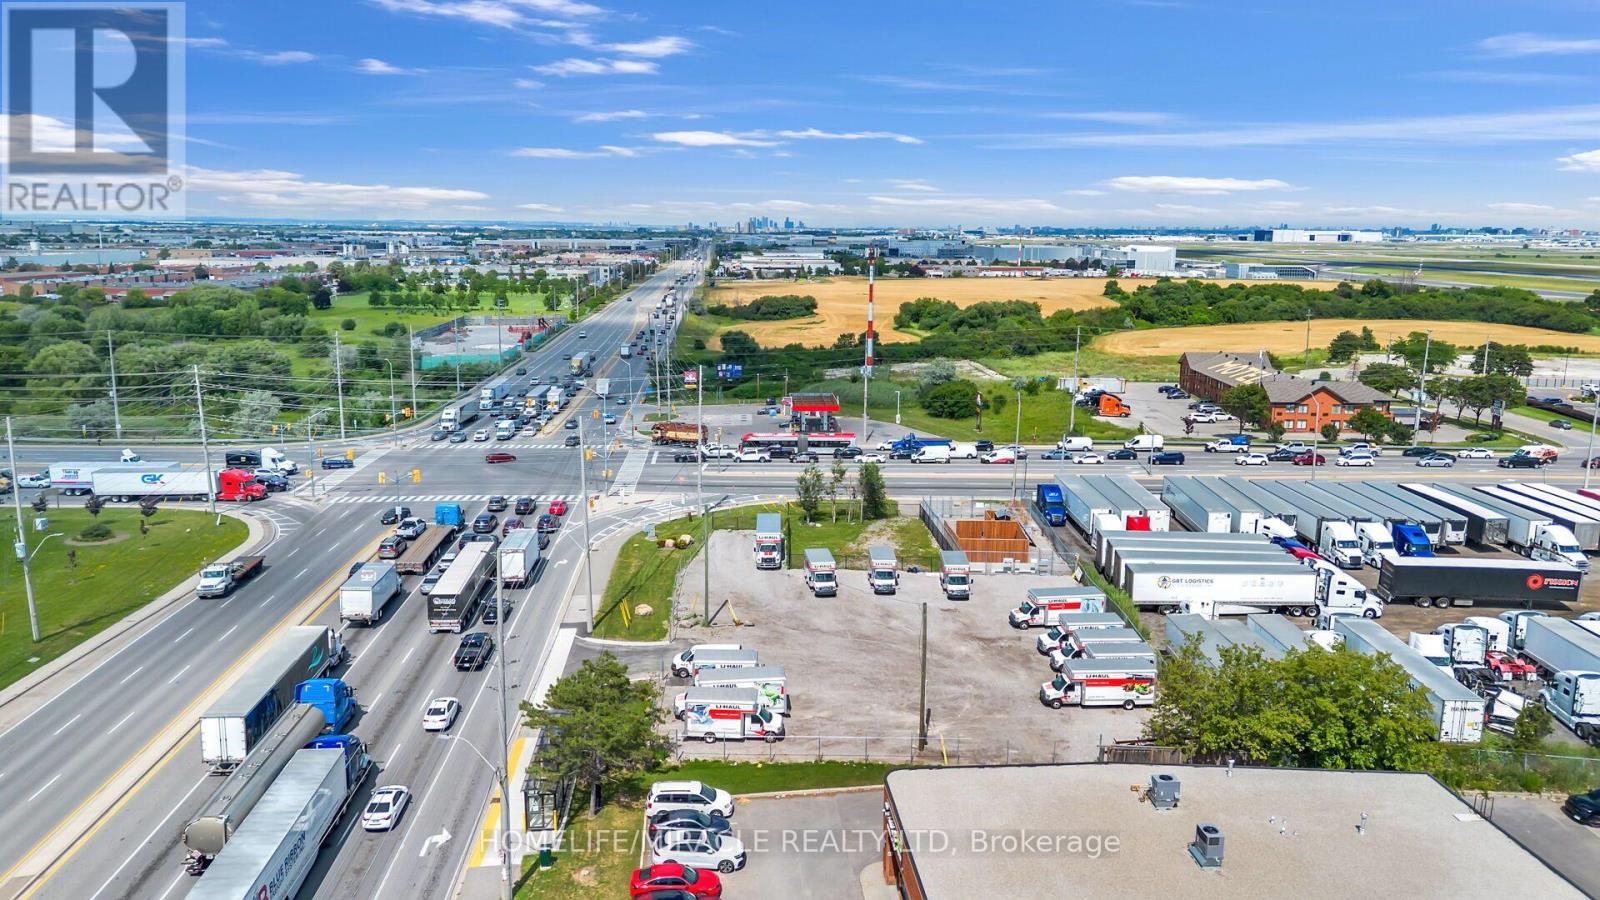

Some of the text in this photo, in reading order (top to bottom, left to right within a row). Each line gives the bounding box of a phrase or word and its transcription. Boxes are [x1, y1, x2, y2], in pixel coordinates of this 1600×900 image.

[1206, 360, 1273, 385] MOTEL
[268, 865, 284, 895] BLUE
[283, 830, 306, 876] RIBBON
